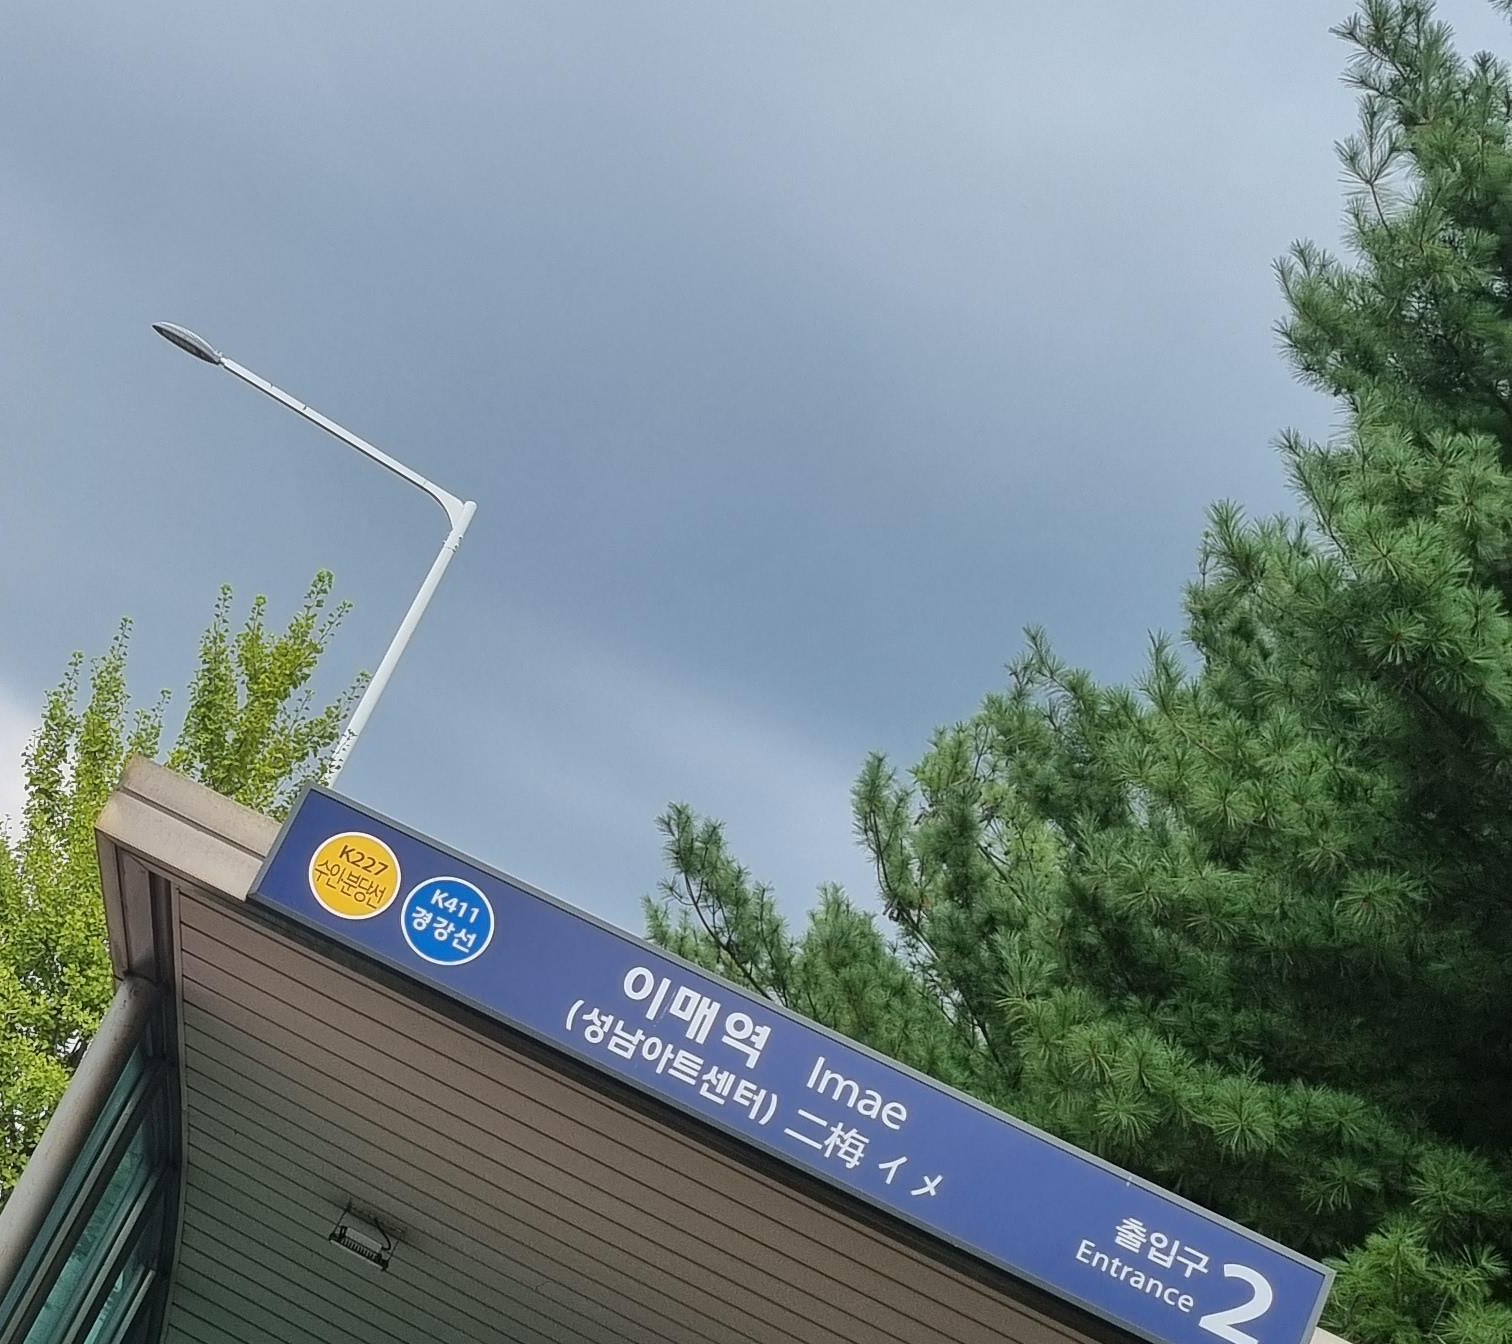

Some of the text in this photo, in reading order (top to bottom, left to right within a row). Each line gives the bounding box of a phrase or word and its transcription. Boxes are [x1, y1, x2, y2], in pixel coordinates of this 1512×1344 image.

[339, 844, 389, 877] K227
[410, 907, 477, 953] 경강선
[430, 889, 480, 924] K411
[623, 966, 908, 1130] 이매역 Imae
[565, 999, 778, 1126] (성남아트센터)
[784, 1108, 870, 1170] 二梅
[1076, 1239, 1194, 1313] Entrance
[1115, 1217, 1209, 1279] 출입구
